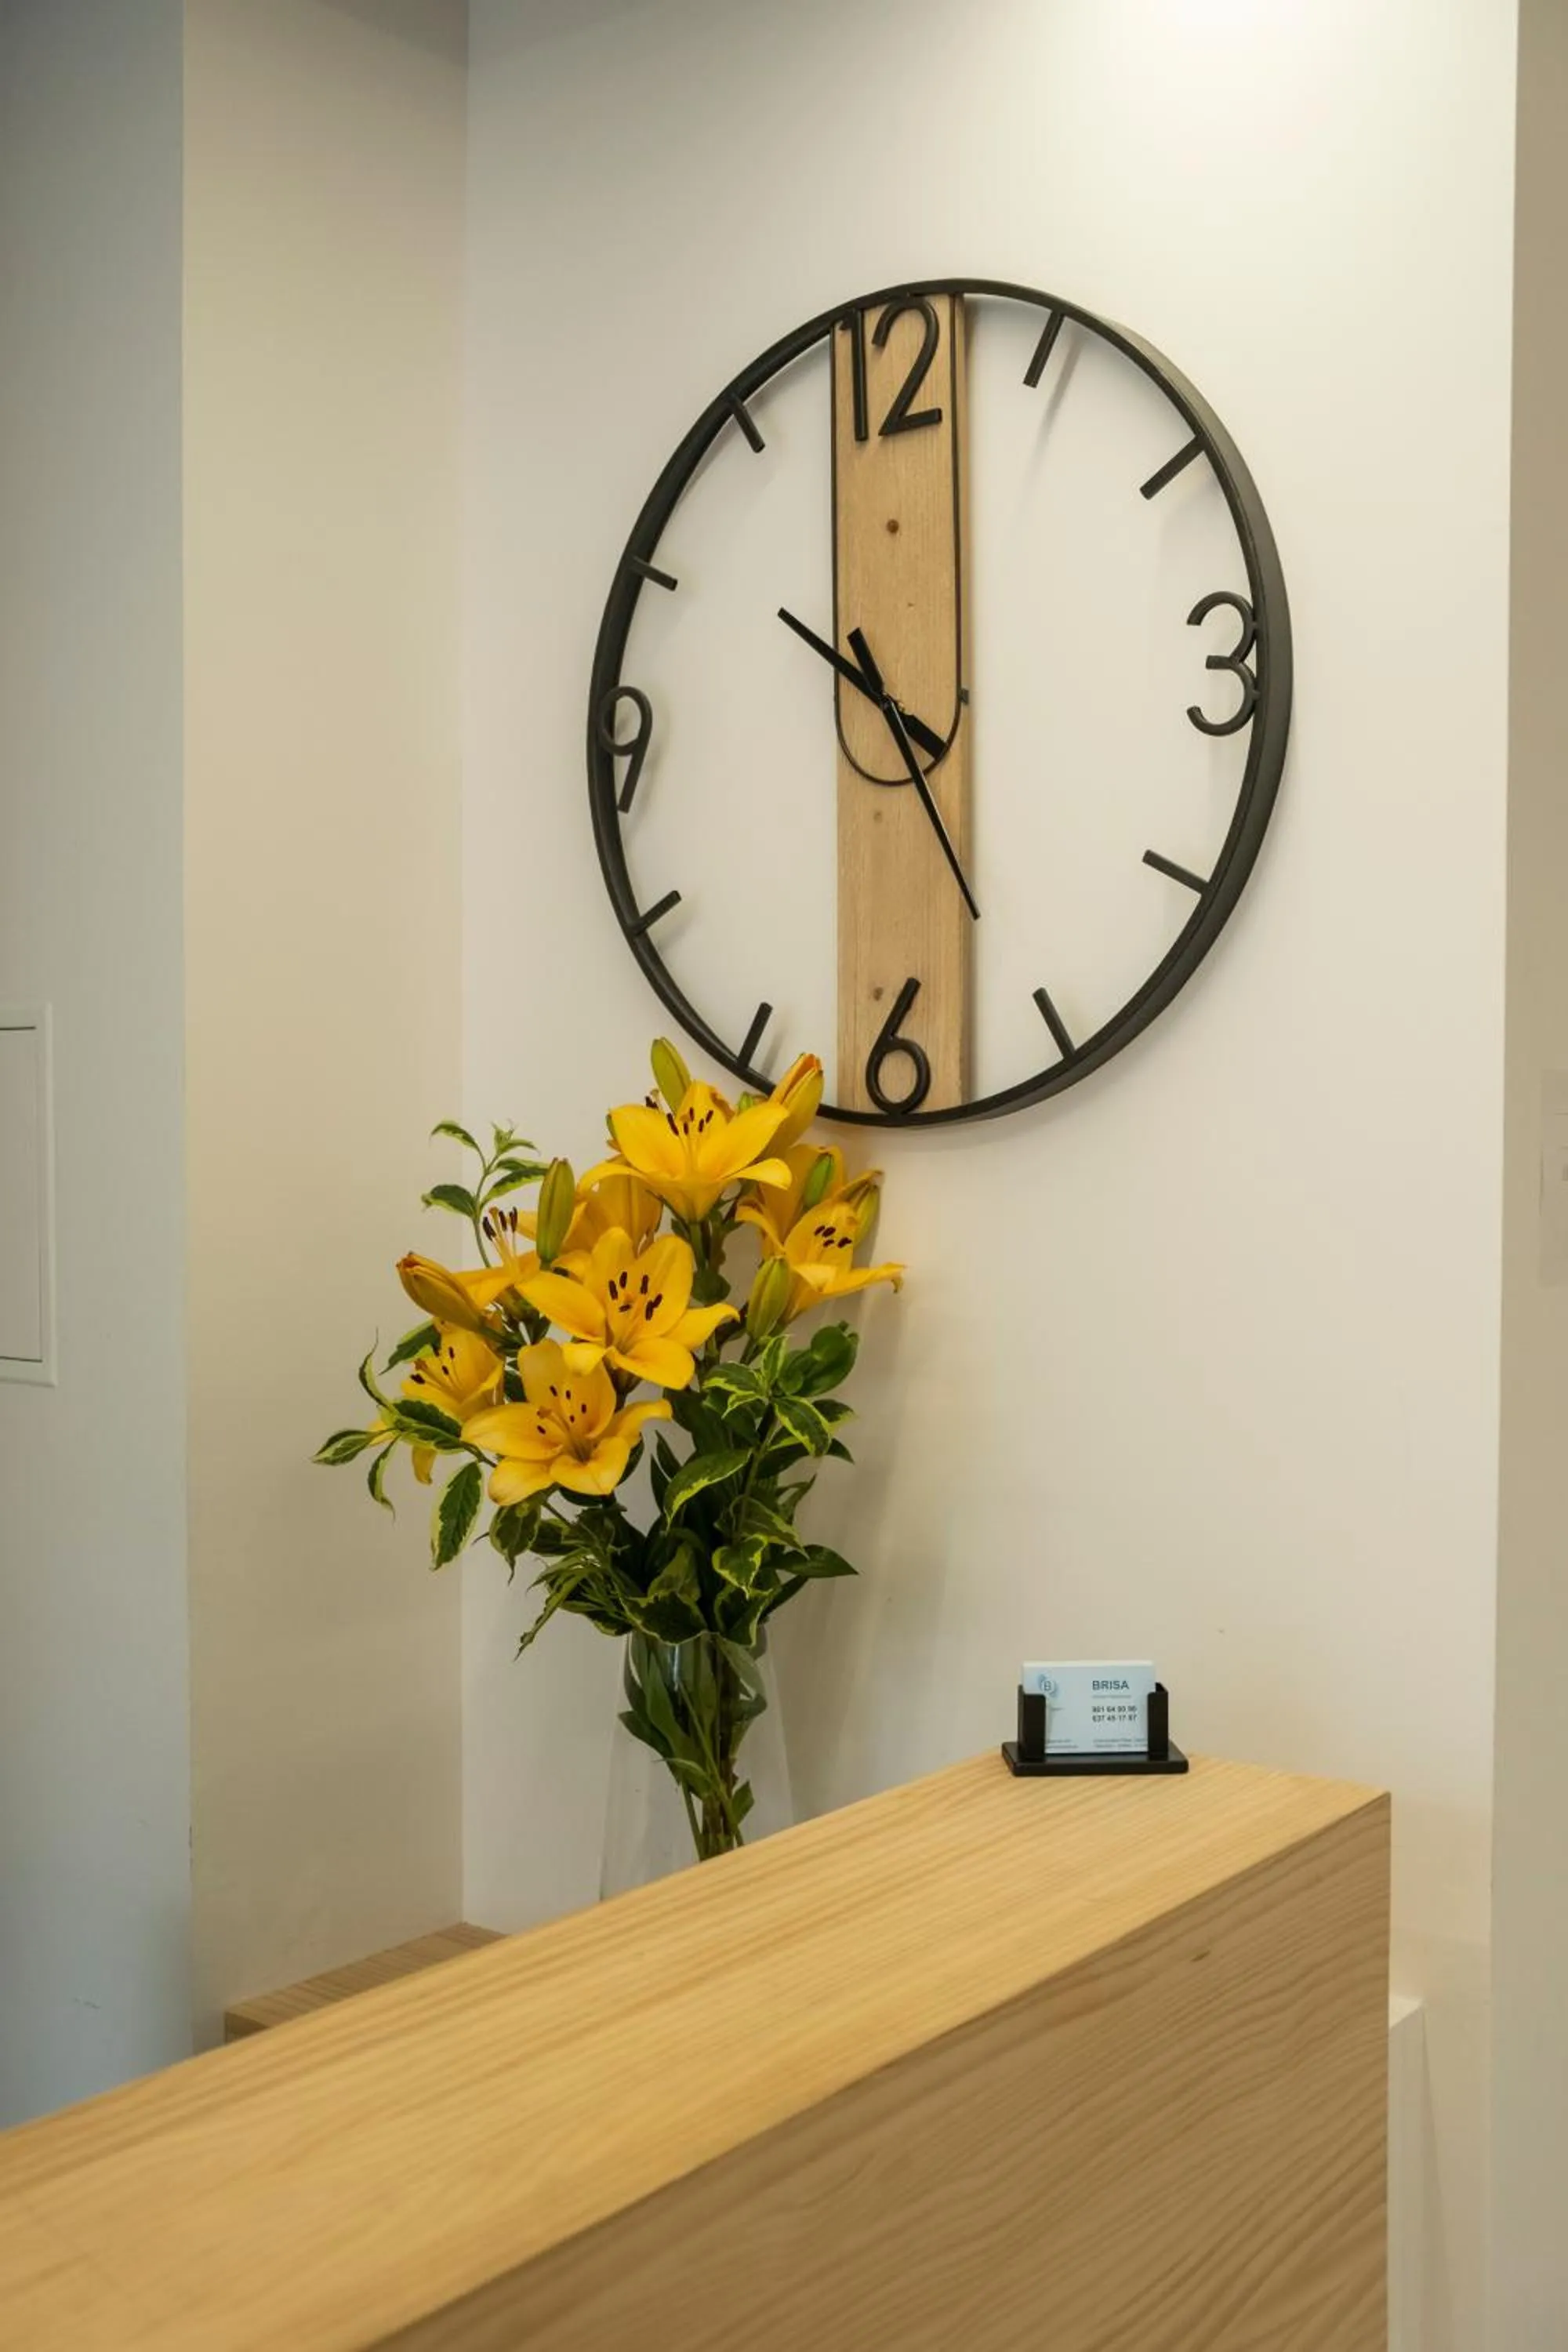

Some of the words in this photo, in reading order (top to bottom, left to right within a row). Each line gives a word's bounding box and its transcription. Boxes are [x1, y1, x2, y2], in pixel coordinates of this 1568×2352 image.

[838, 294, 942, 442] 12
[1186, 590, 1258, 737] 3
[599, 685, 653, 814] 9
[866, 977, 931, 1115] 6
[1092, 1680, 1130, 1690] BRISA
